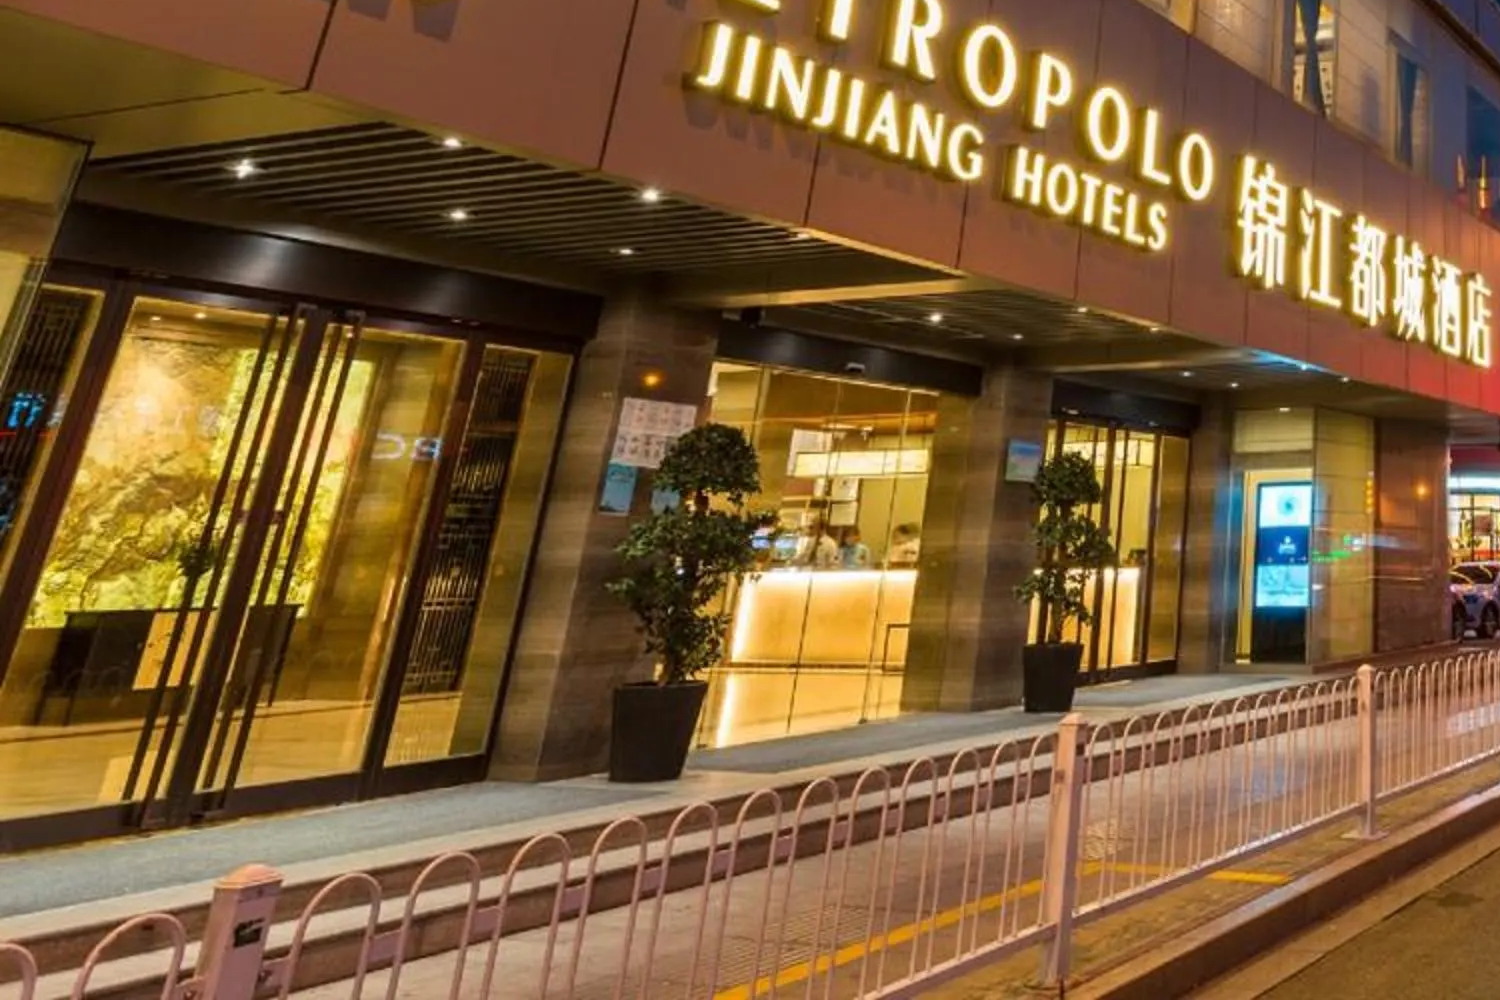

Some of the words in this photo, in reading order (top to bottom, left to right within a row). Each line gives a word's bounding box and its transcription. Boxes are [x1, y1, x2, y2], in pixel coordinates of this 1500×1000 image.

[695, 20, 985, 182] JINJIANG
[1012, 146, 1170, 252] HOTELS
[1237, 153, 1492, 369] 锦江都城酒店
